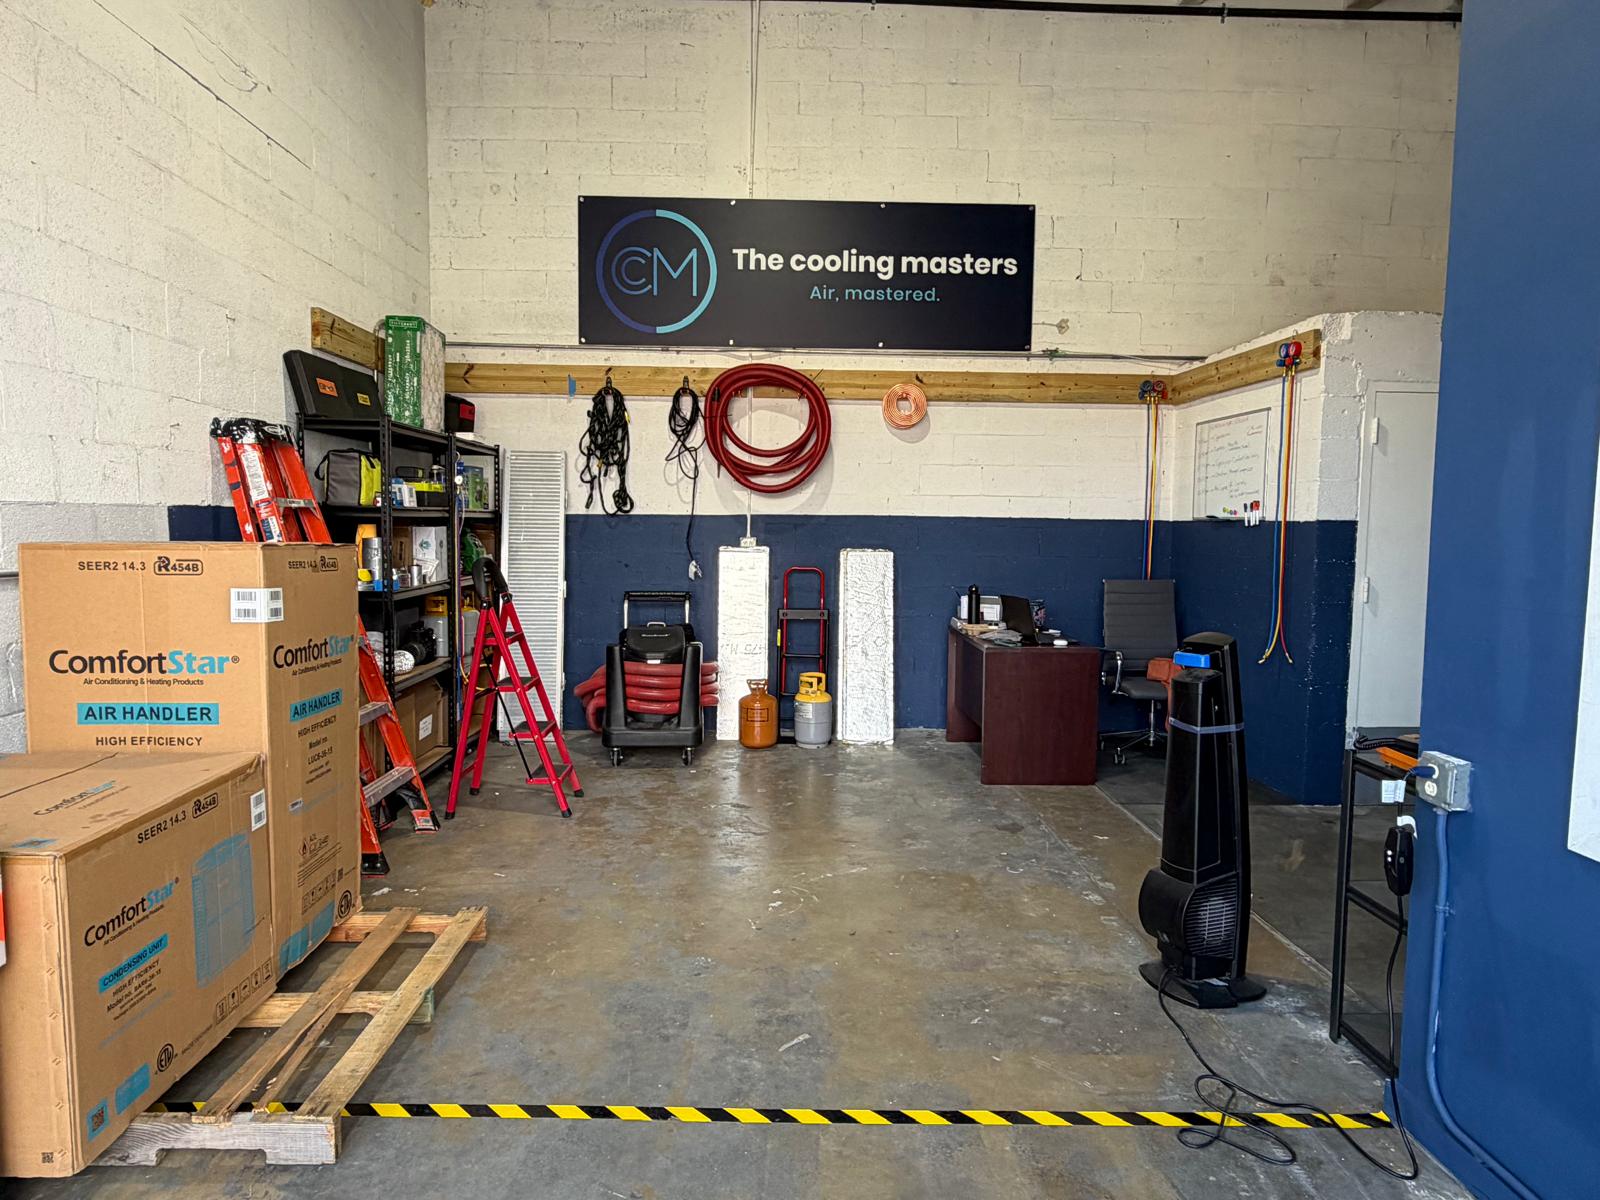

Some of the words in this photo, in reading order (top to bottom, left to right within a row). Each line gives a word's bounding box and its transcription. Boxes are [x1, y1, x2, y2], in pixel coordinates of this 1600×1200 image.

[732, 248, 784, 271] The
[790, 248, 894, 280] cooling
[901, 254, 1018, 275] masters
[810, 285, 839, 302] Air,
[845, 287, 940, 301] mastered.
[78, 561, 118, 571] SEER2
[122, 562, 146, 571] 14.3
[157, 556, 199, 572] R454B
[288, 560, 305, 569] SEER2
[95, 678, 138, 686] Conditioning
[147, 678, 171, 686] Heating
[173, 678, 204, 686] Products
[293, 704, 308, 718] AIR
[308, 691, 340, 713] HANDLER
[84, 706, 117, 720] AIR
[122, 706, 212, 721] HANDLER
[96, 736, 126, 746] HIGH
[131, 736, 203, 746] EFFICIENCY
[138, 820, 167, 844] SEER2
[169, 810, 187, 827] 14.3
[103, 949, 148, 986] CONDENSING
[149, 939, 163, 954] UNIT
